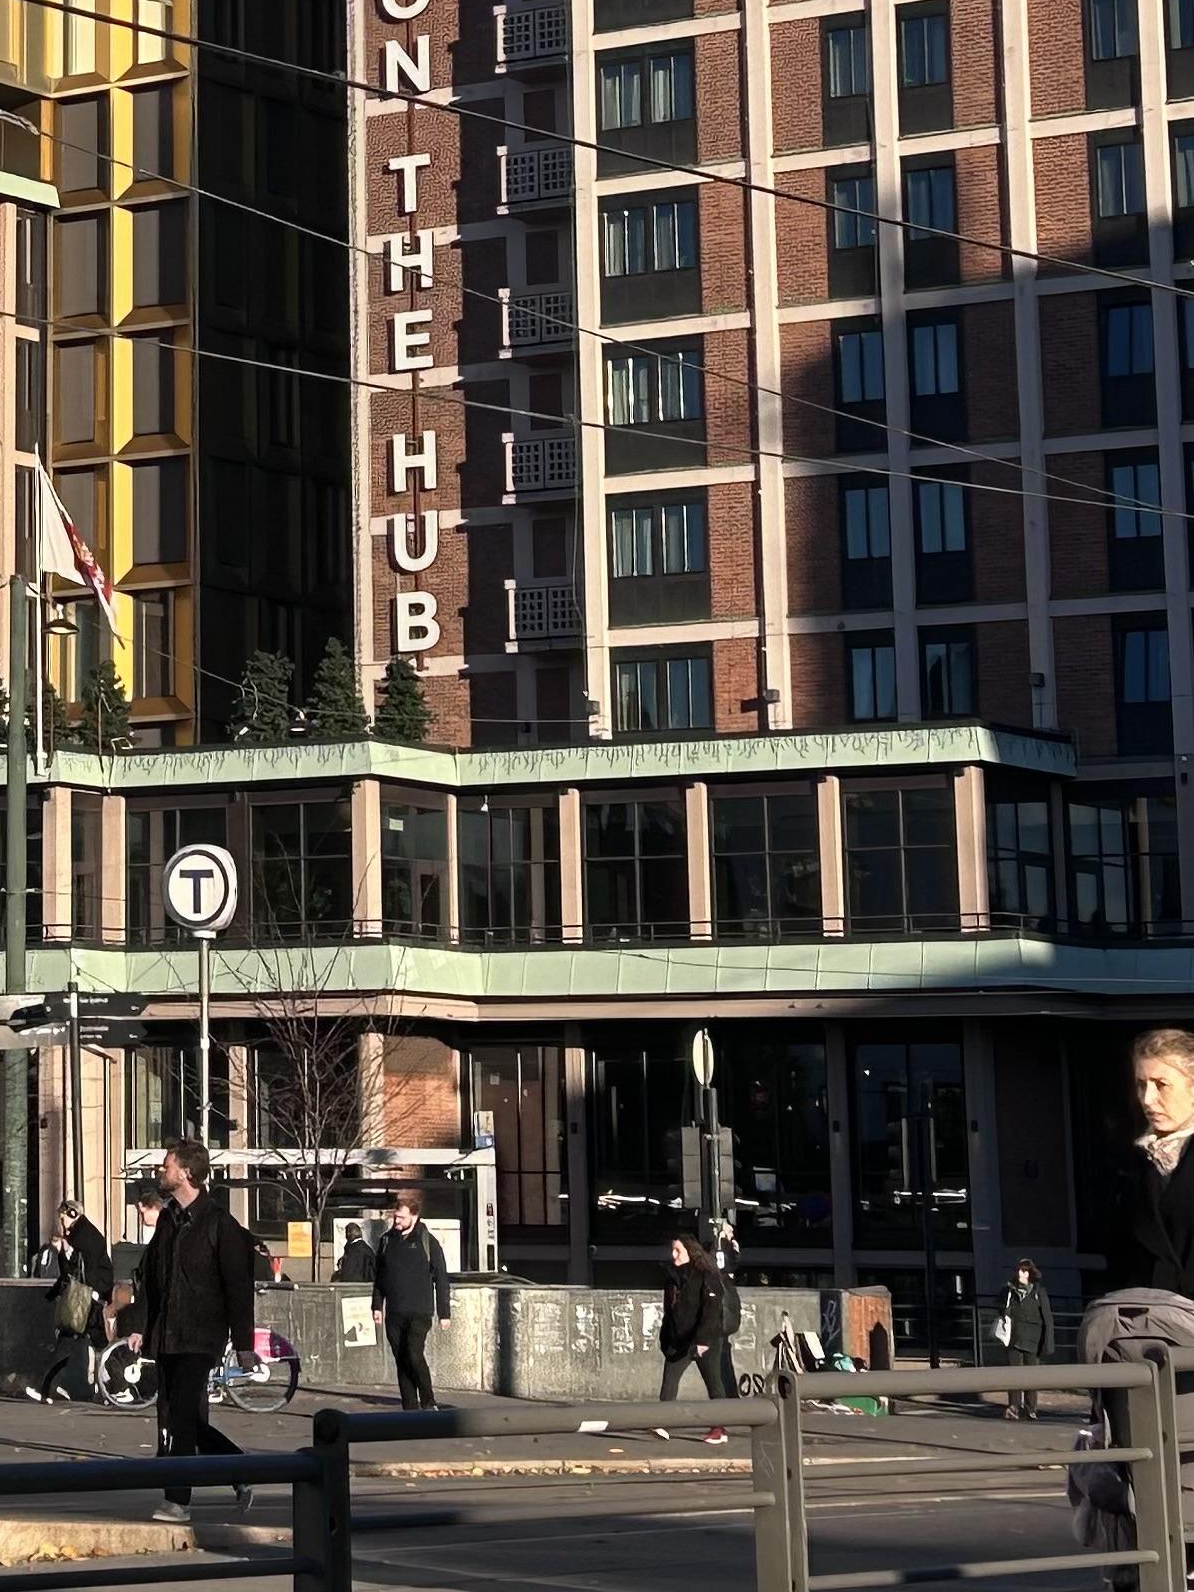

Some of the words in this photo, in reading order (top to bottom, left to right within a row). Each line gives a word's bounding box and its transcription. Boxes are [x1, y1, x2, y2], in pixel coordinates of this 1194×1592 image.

[388, 152, 433, 371] THE
[393, 430, 441, 654] HUB
[179, 869, 214, 914] T
